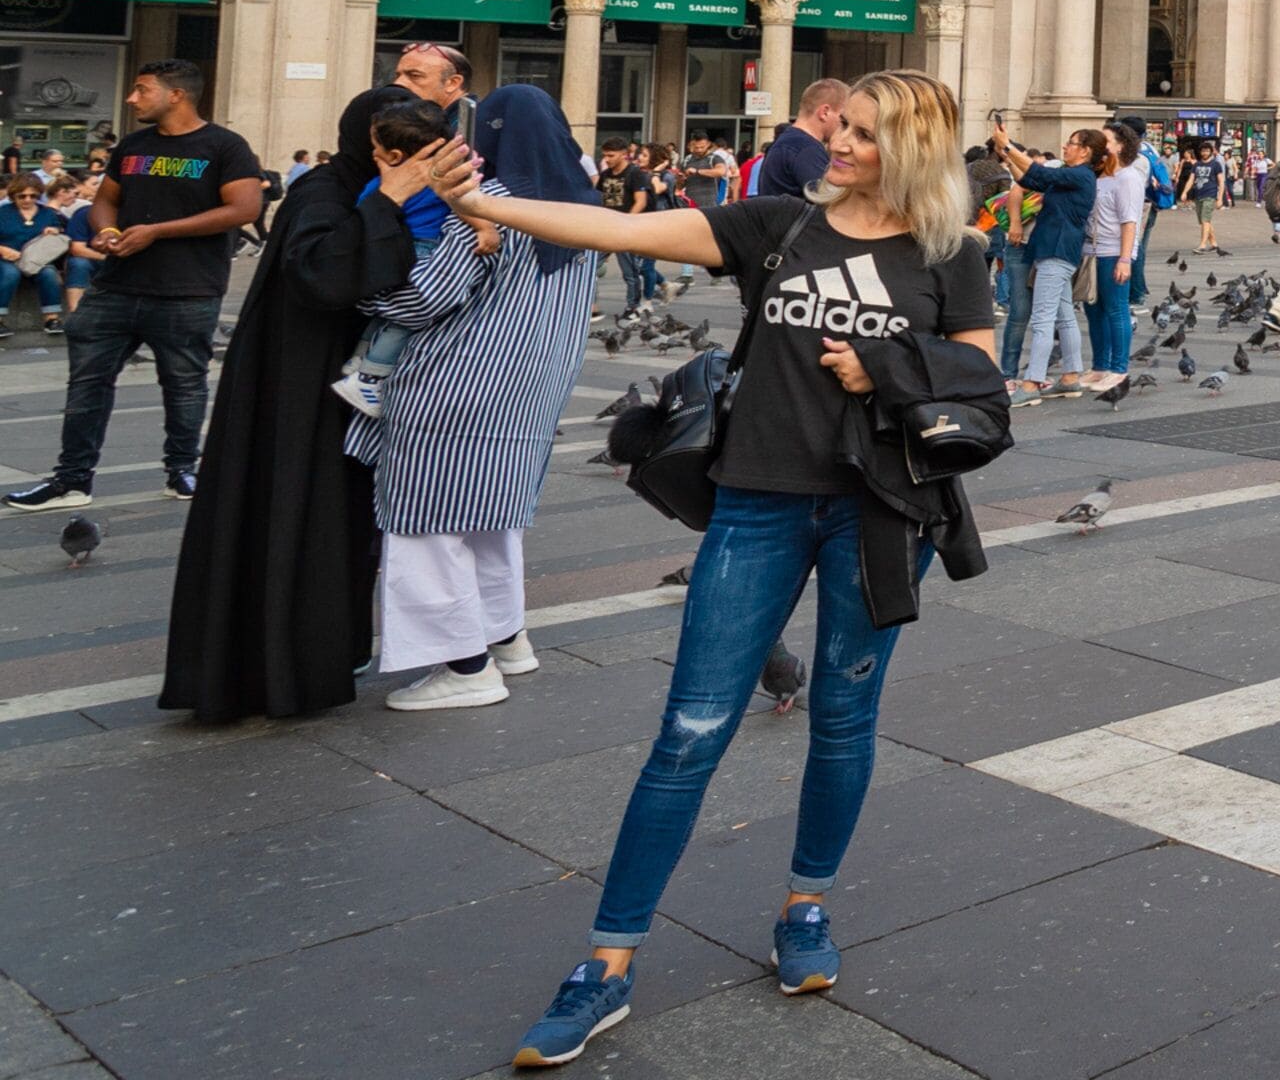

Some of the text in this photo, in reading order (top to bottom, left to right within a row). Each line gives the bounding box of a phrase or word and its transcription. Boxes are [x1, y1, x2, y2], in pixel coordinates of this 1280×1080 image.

[654, 1, 675, 10] ASTI
[689, 4, 738, 14] SANREMO
[796, 7, 908, 21] LANO ASTI SANREMO
[745, 66, 756, 85] M
[764, 293, 909, 338] adidas
